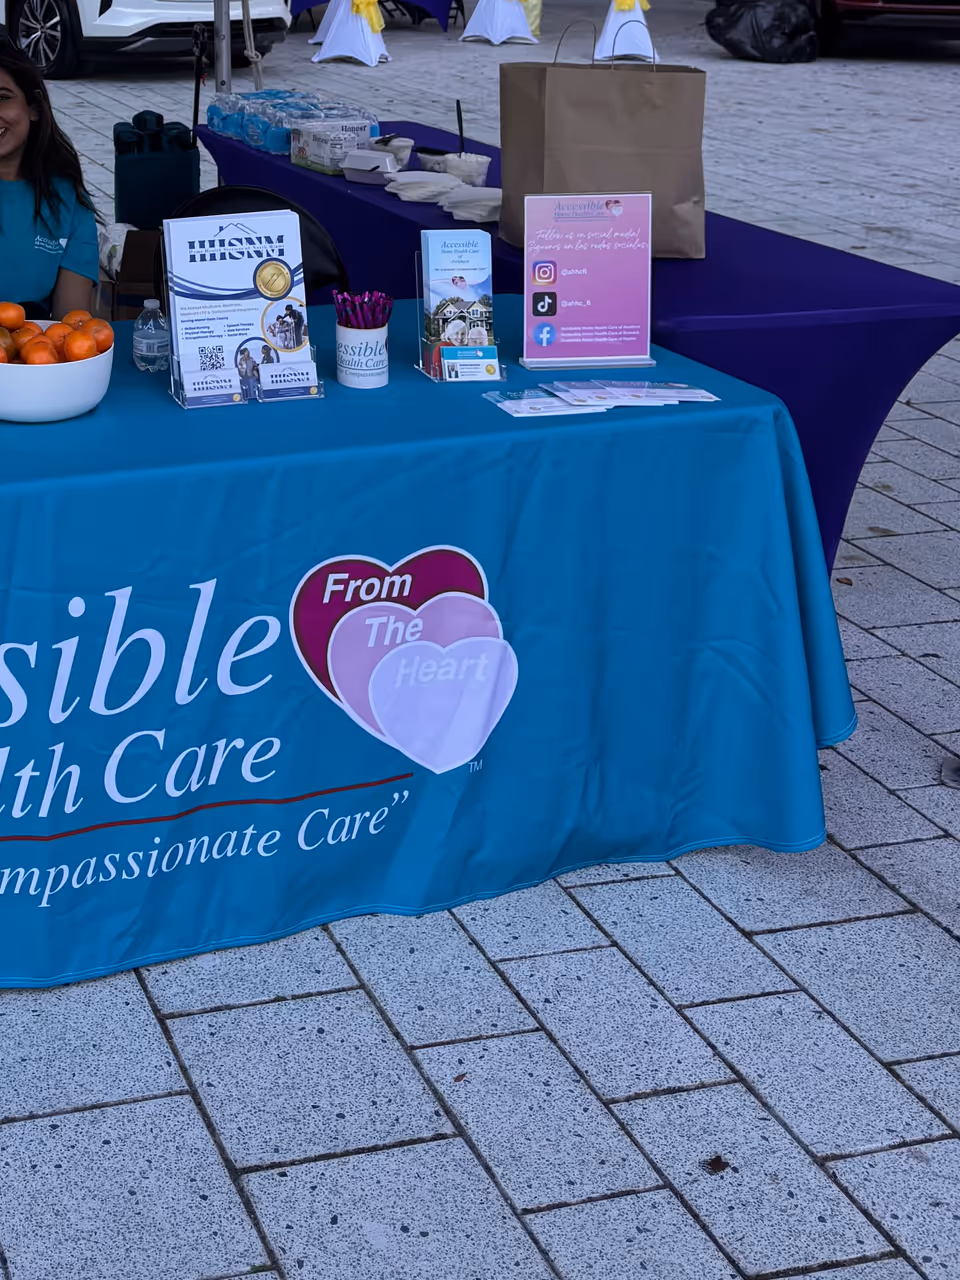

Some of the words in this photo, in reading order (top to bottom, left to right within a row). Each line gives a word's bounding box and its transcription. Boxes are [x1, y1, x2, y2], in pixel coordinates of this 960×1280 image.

[337, 340, 385, 358] essible
[323, 569, 412, 604] From
[363, 612, 424, 648] The
[393, 651, 489, 689] Heart
[104, 726, 282, 803] Care
[296, 787, 411, 850] Care"
